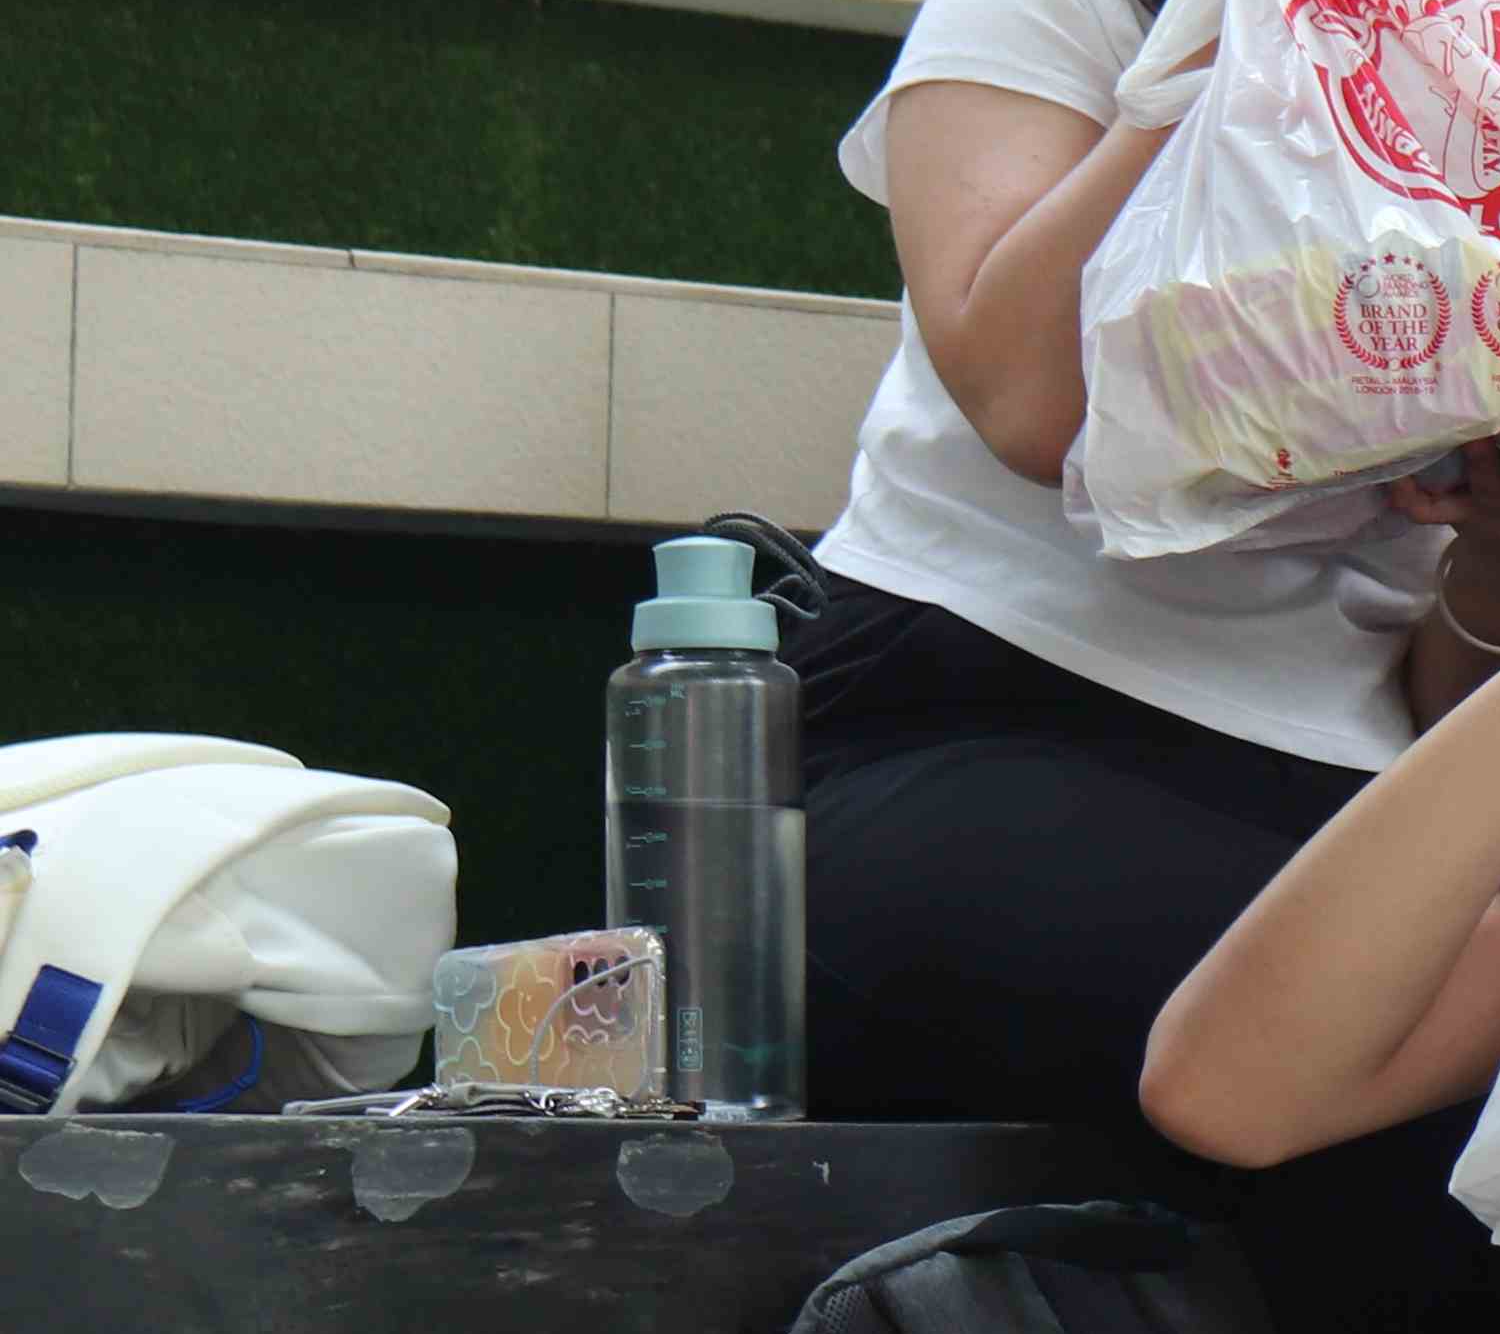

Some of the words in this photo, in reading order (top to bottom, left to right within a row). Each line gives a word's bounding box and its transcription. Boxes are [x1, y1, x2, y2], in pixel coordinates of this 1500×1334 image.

[1360, 304, 1427, 319] BRAND
[1359, 319, 1382, 334] OF
[1388, 320, 1428, 335] THE
[1370, 336, 1417, 352] YEAR
